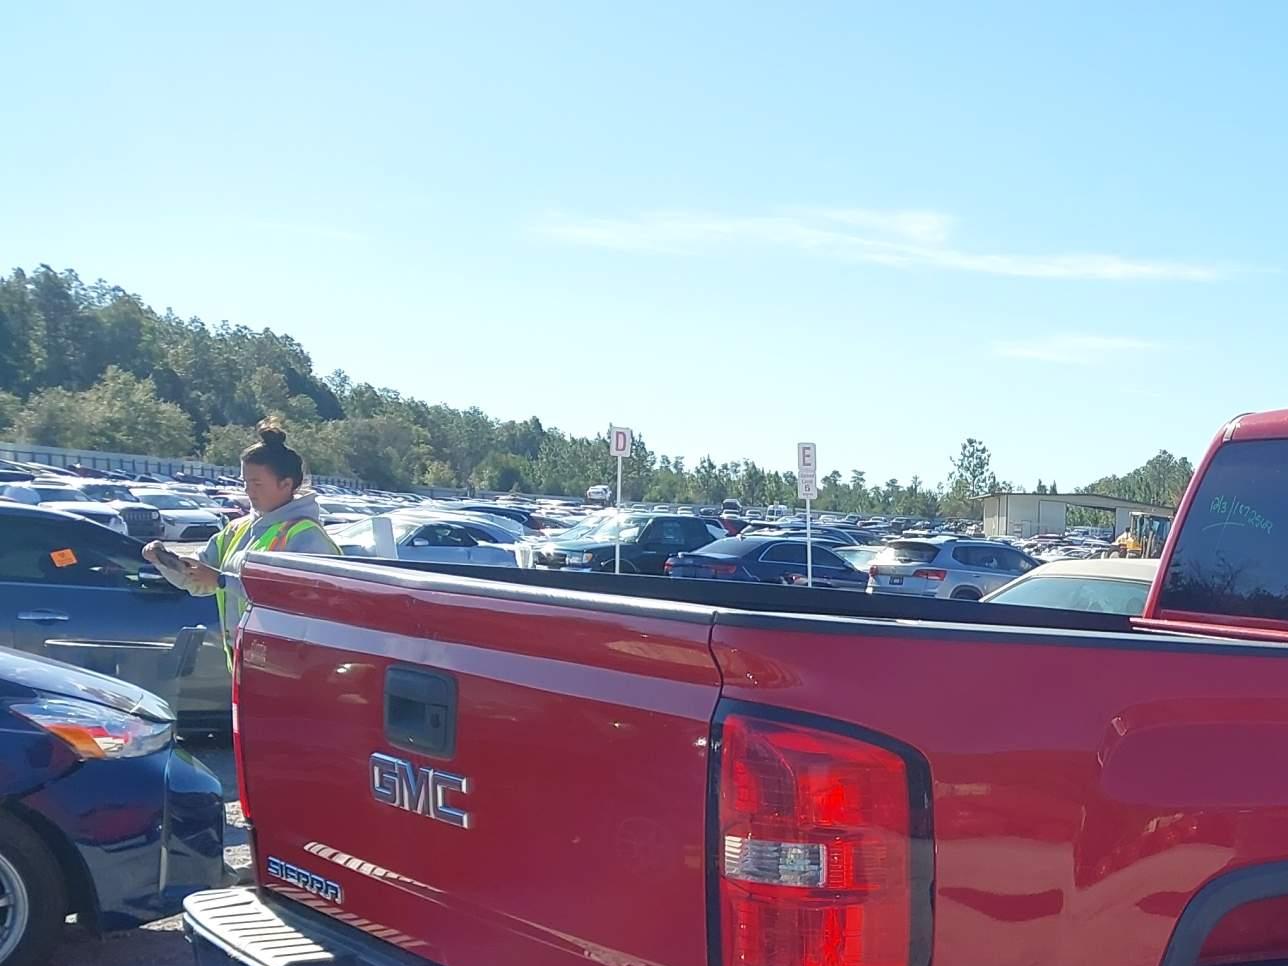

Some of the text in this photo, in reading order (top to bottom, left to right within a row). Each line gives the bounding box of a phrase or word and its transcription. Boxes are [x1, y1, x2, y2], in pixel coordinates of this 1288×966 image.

[615, 431, 626, 451] D
[802, 446, 811, 467] E
[369, 751, 469, 829] GMC
[267, 855, 344, 905] SIERRA
